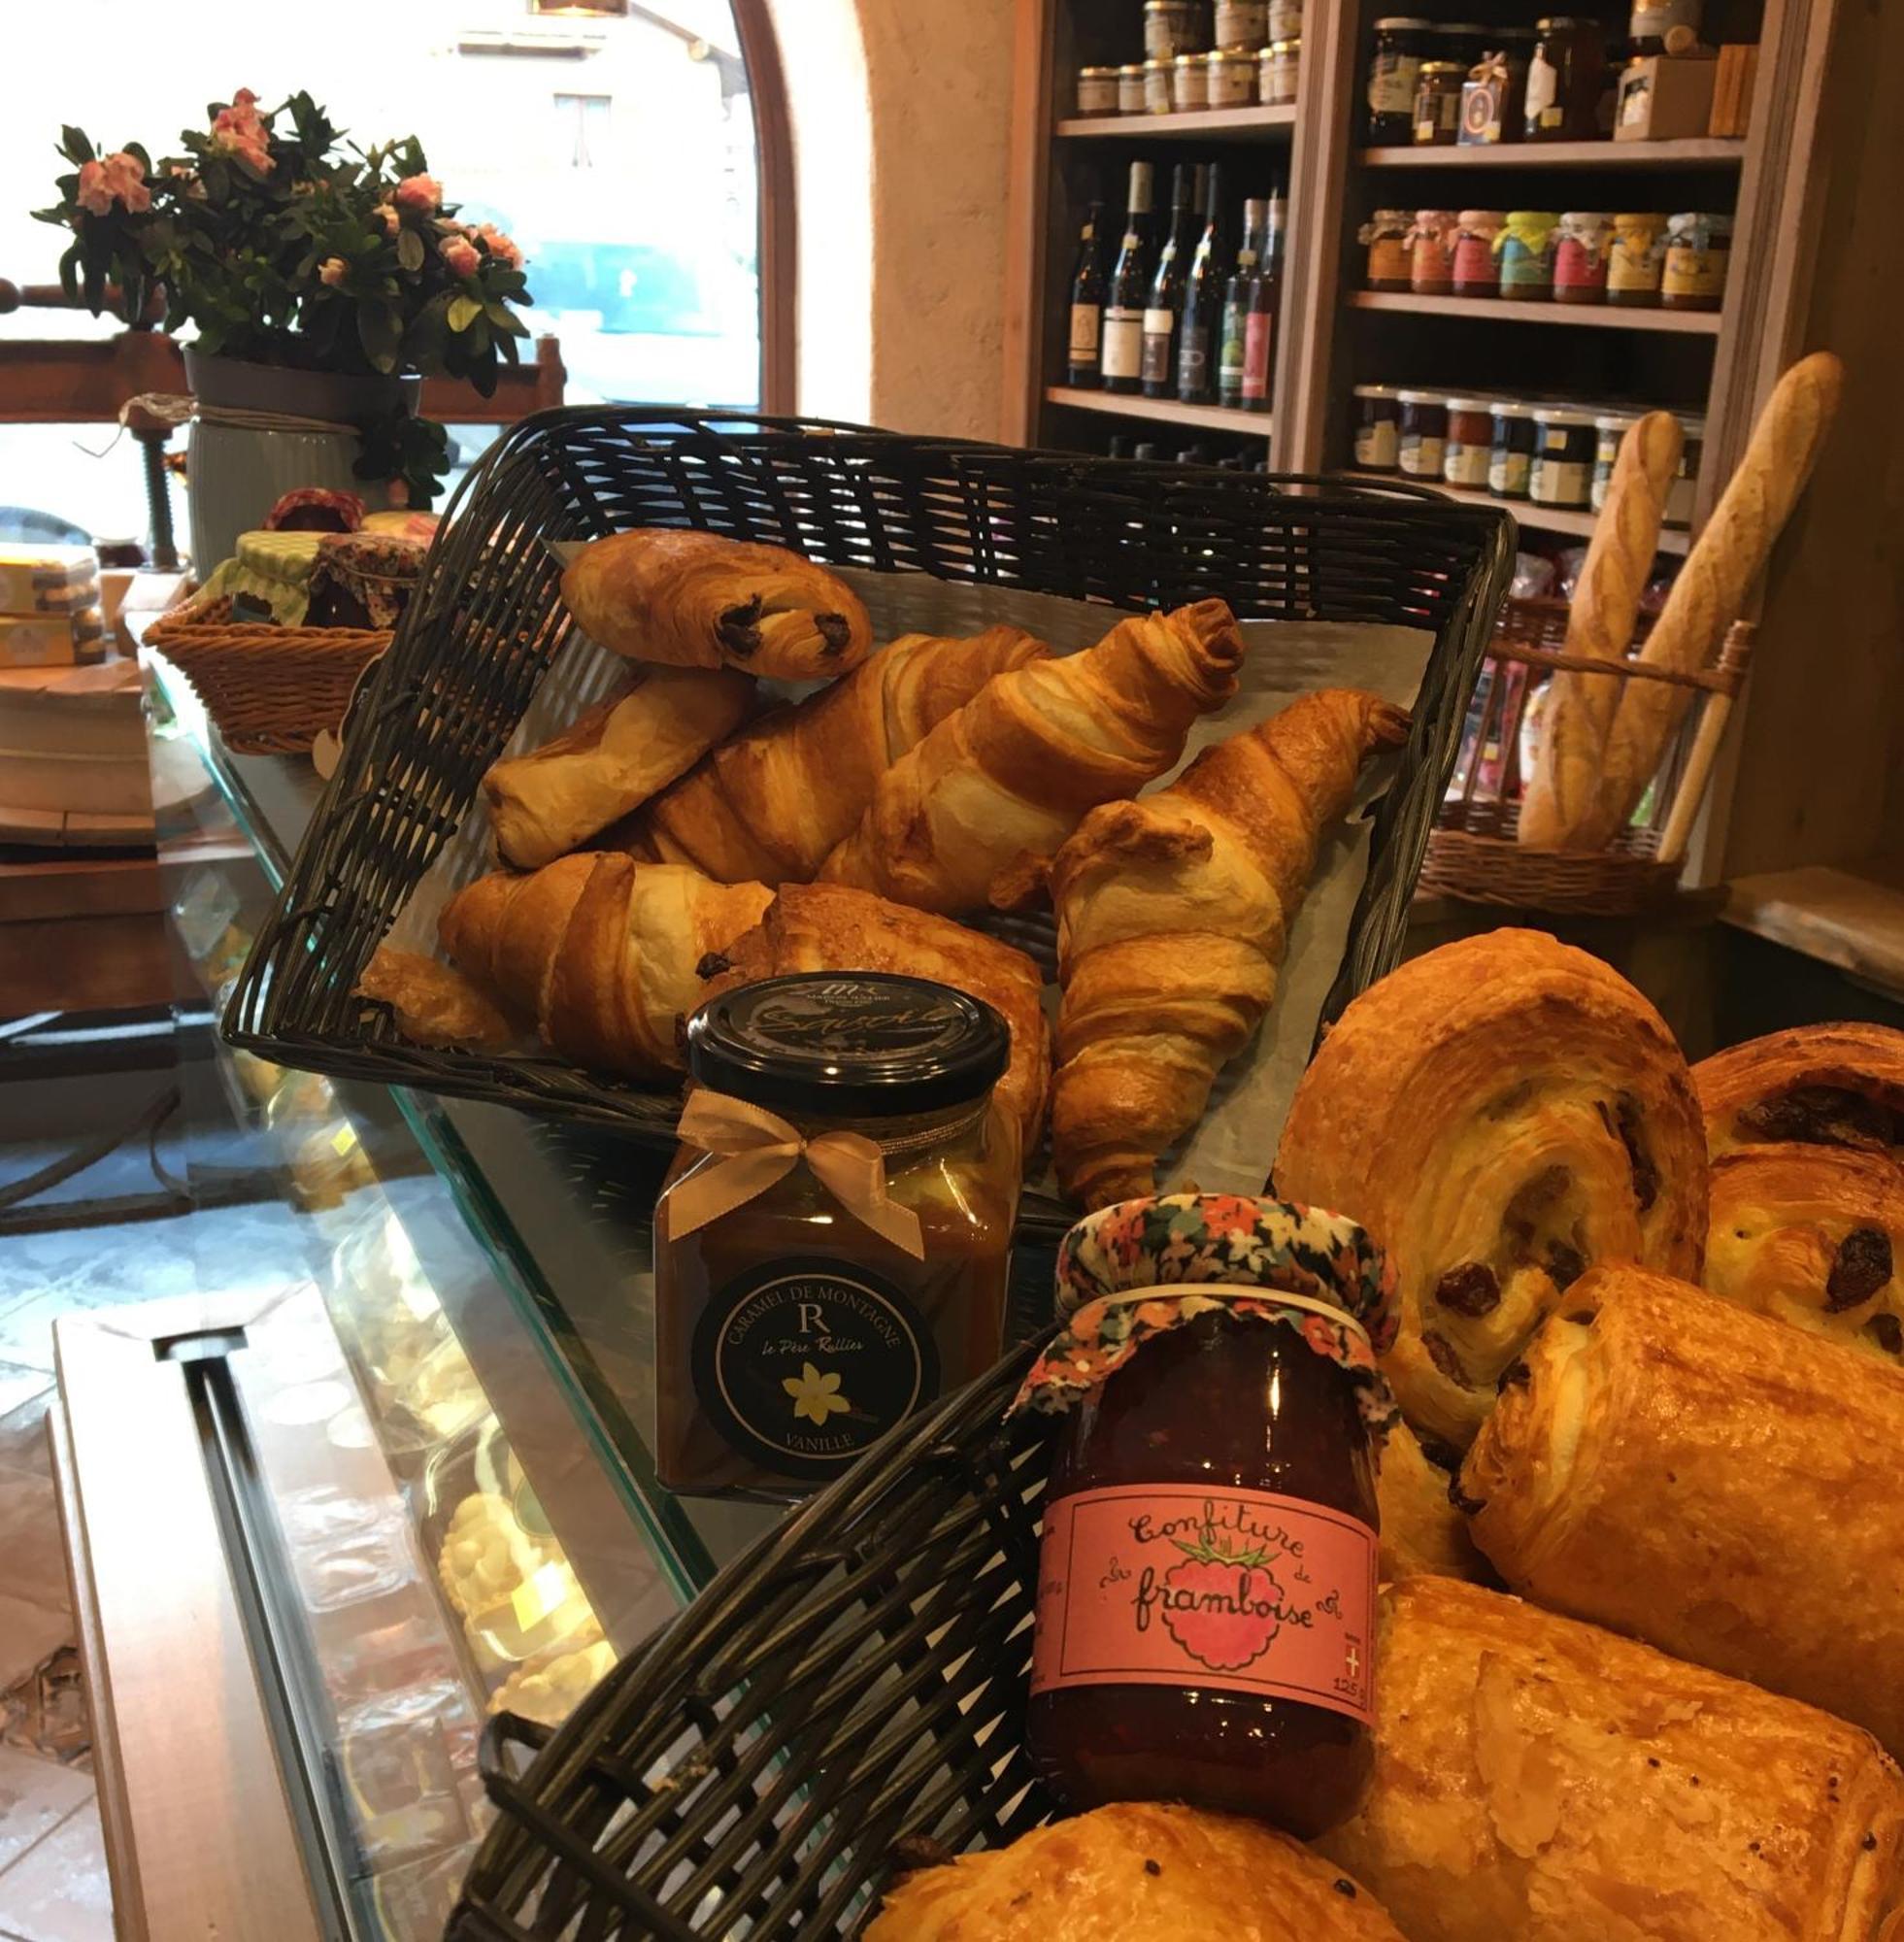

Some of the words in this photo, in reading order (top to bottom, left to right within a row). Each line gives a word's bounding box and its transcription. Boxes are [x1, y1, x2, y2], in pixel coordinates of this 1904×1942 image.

[728, 1290, 785, 1345] CARAMEL
[790, 1286, 815, 1299] DE
[818, 1287, 901, 1348] MONTAGNE
[798, 1303, 831, 1333] R
[785, 1431, 853, 1452] VANILLE
[1128, 1499, 1304, 1558] Confiture
[1293, 1564, 1311, 1584] de
[1131, 1566, 1314, 1632] framboise
